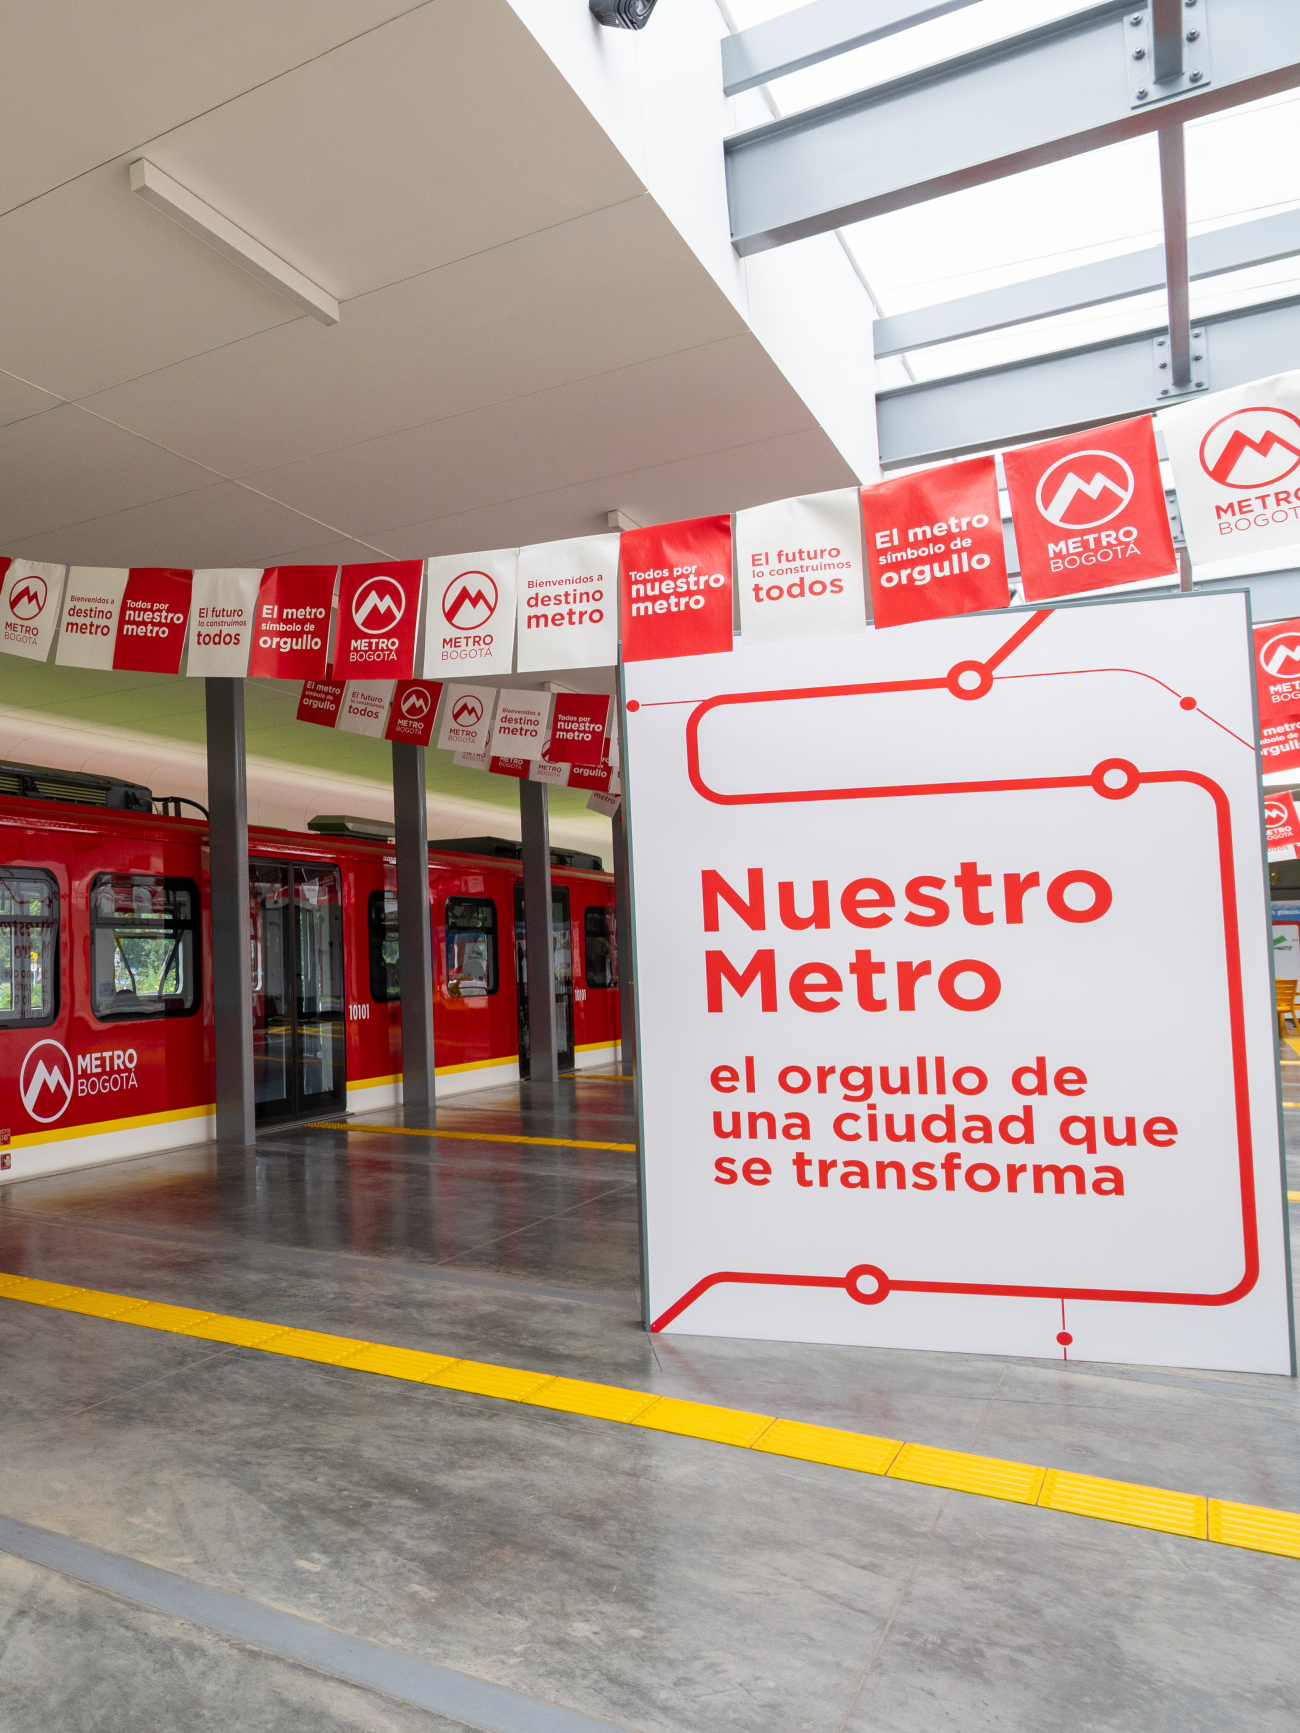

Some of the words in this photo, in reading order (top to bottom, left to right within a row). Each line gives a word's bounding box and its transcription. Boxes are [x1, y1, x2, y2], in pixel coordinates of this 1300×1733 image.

[1218, 505, 1300, 536] BOGOT
[875, 530, 899, 550] El
[907, 513, 989, 543] metro
[1047, 526, 1138, 558] METRO
[751, 552, 770, 568] El
[776, 546, 841, 564] futuro
[878, 542, 945, 566] símbolo
[950, 535, 972, 554] de
[1050, 541, 1141, 572] BOGOTÁ
[629, 567, 670, 582] Todos
[673, 563, 698, 579] por
[752, 569, 765, 579] lo
[768, 560, 852, 577] construimos
[880, 552, 991, 588] orgullo
[527, 575, 594, 589] Bienvenidos
[631, 572, 725, 598] nuestro
[752, 574, 844, 603] todos
[70, 595, 109, 605] Bienvenidos
[126, 600, 152, 610] Todos
[153, 603, 169, 611] por
[526, 589, 604, 608] destino
[631, 594, 705, 617] metro
[68, 605, 112, 620] destino
[125, 609, 184, 624] nuestro
[198, 607, 209, 618] El
[211, 607, 244, 618] futuro
[262, 605, 278, 618] El
[283, 606, 326, 619] metro
[527, 608, 604, 629] metro
[5, 621, 39, 637] METRO
[65, 621, 110, 637] metro
[123, 624, 169, 638] metro
[206, 619, 247, 628] construimos
[261, 621, 301, 632] símbolo
[303, 622, 315, 632] de
[4, 632, 38, 646] BOGOTÁ
[196, 630, 241, 646] todos
[259, 634, 322, 653] orgullo
[350, 638, 399, 651] METRO
[442, 634, 494, 649] METRO
[349, 648, 397, 662] BOGOTÁ
[441, 646, 493, 661] BOGOTÁ
[306, 681, 315, 689] El
[316, 683, 341, 695] metro
[303, 698, 336, 711] orgullo
[360, 693, 383, 703] futuro
[348, 704, 380, 719] todos
[397, 719, 424, 729] METRO
[500, 715, 539, 726] destino
[557, 721, 603, 732] nuestro
[449, 728, 477, 738] METRO
[499, 726, 538, 737] metro
[556, 731, 592, 741] metro
[1287, 732, 1299, 740] de
[539, 764, 562, 773] METRO
[573, 766, 607, 778] orgullo
[593, 792, 616, 804] metro
[701, 861, 1113, 932] Nuestro
[705, 949, 1002, 1013] Metro
[349, 1003, 370, 1020] 10101
[77, 1048, 137, 1075] METRO
[78, 1068, 139, 1097] BOGOTÁ
[710, 1056, 757, 1094] el
[777, 1056, 989, 1102] orgullo
[1011, 1056, 1087, 1097] de
[712, 1108, 811, 1142] una
[833, 1104, 1035, 1146] ciudad
[1059, 1114, 1179, 1155] que
[713, 1153, 772, 1187] se
[793, 1151, 1125, 1197] transforma
